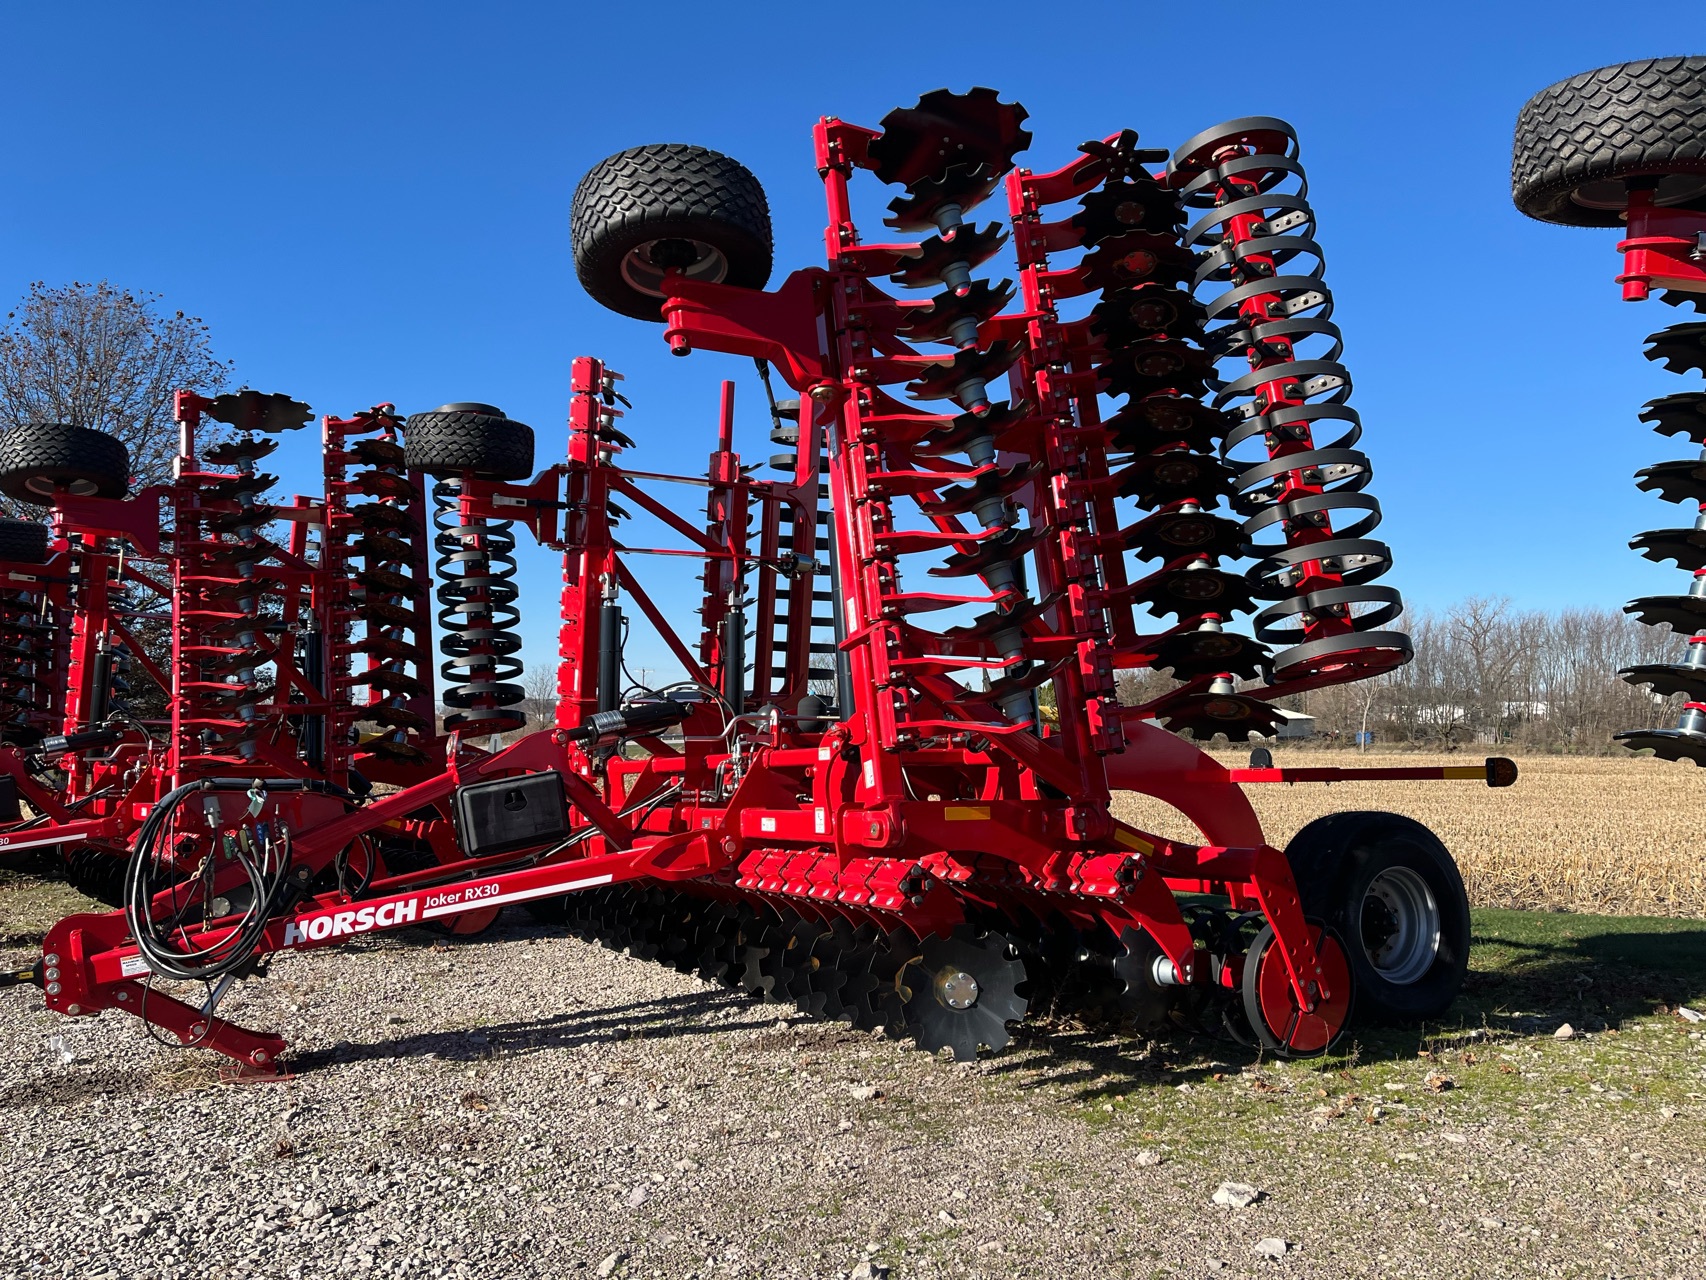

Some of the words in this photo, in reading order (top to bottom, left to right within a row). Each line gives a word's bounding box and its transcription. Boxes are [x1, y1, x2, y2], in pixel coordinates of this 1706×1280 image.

[423, 892, 462, 909] Joker
[464, 883, 500, 901] RX30
[283, 898, 418, 946] HORSCH
